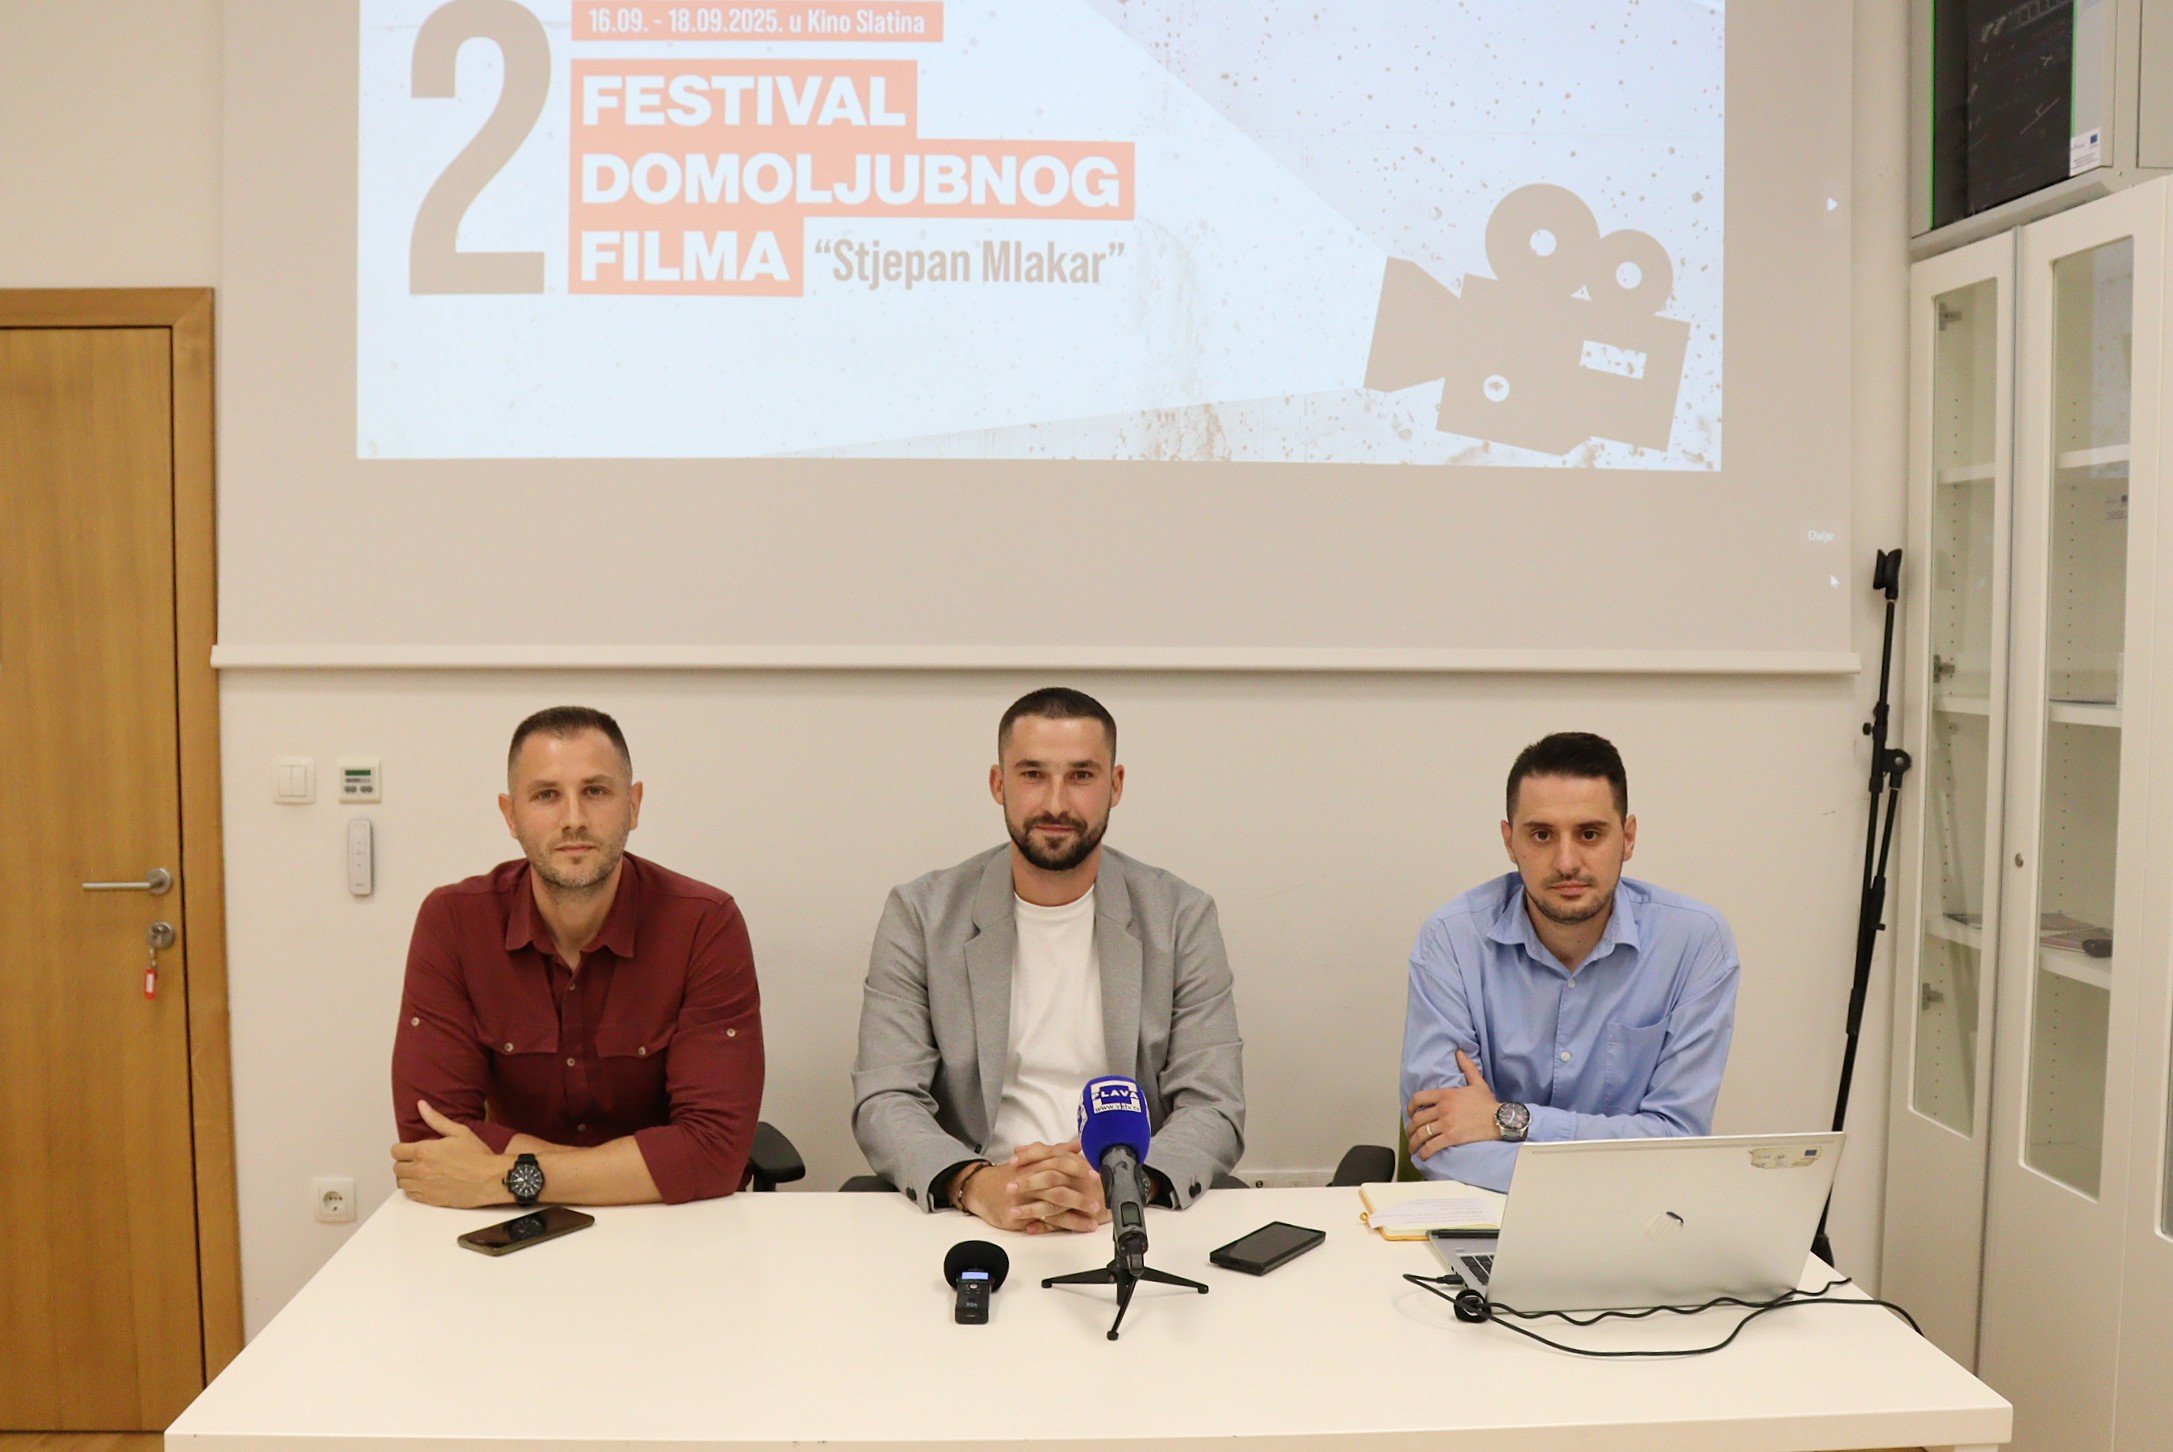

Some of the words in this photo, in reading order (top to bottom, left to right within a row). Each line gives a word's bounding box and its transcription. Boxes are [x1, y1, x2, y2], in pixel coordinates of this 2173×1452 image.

[589, 7, 649, 33] 16.09.
[669, 7, 784, 33] 18.09.2025.
[789, 14, 802, 33] u
[808, 9, 850, 34] Kino
[856, 8, 925, 34] Slatina
[582, 75, 906, 127] FESTIVAL
[409, 0, 552, 296] 2
[581, 152, 1119, 207] DOMOLJUBNOG
[581, 230, 791, 282] FILMA
[814, 238, 970, 290] “Stjepan
[982, 240, 1125, 284] Mlakar”
